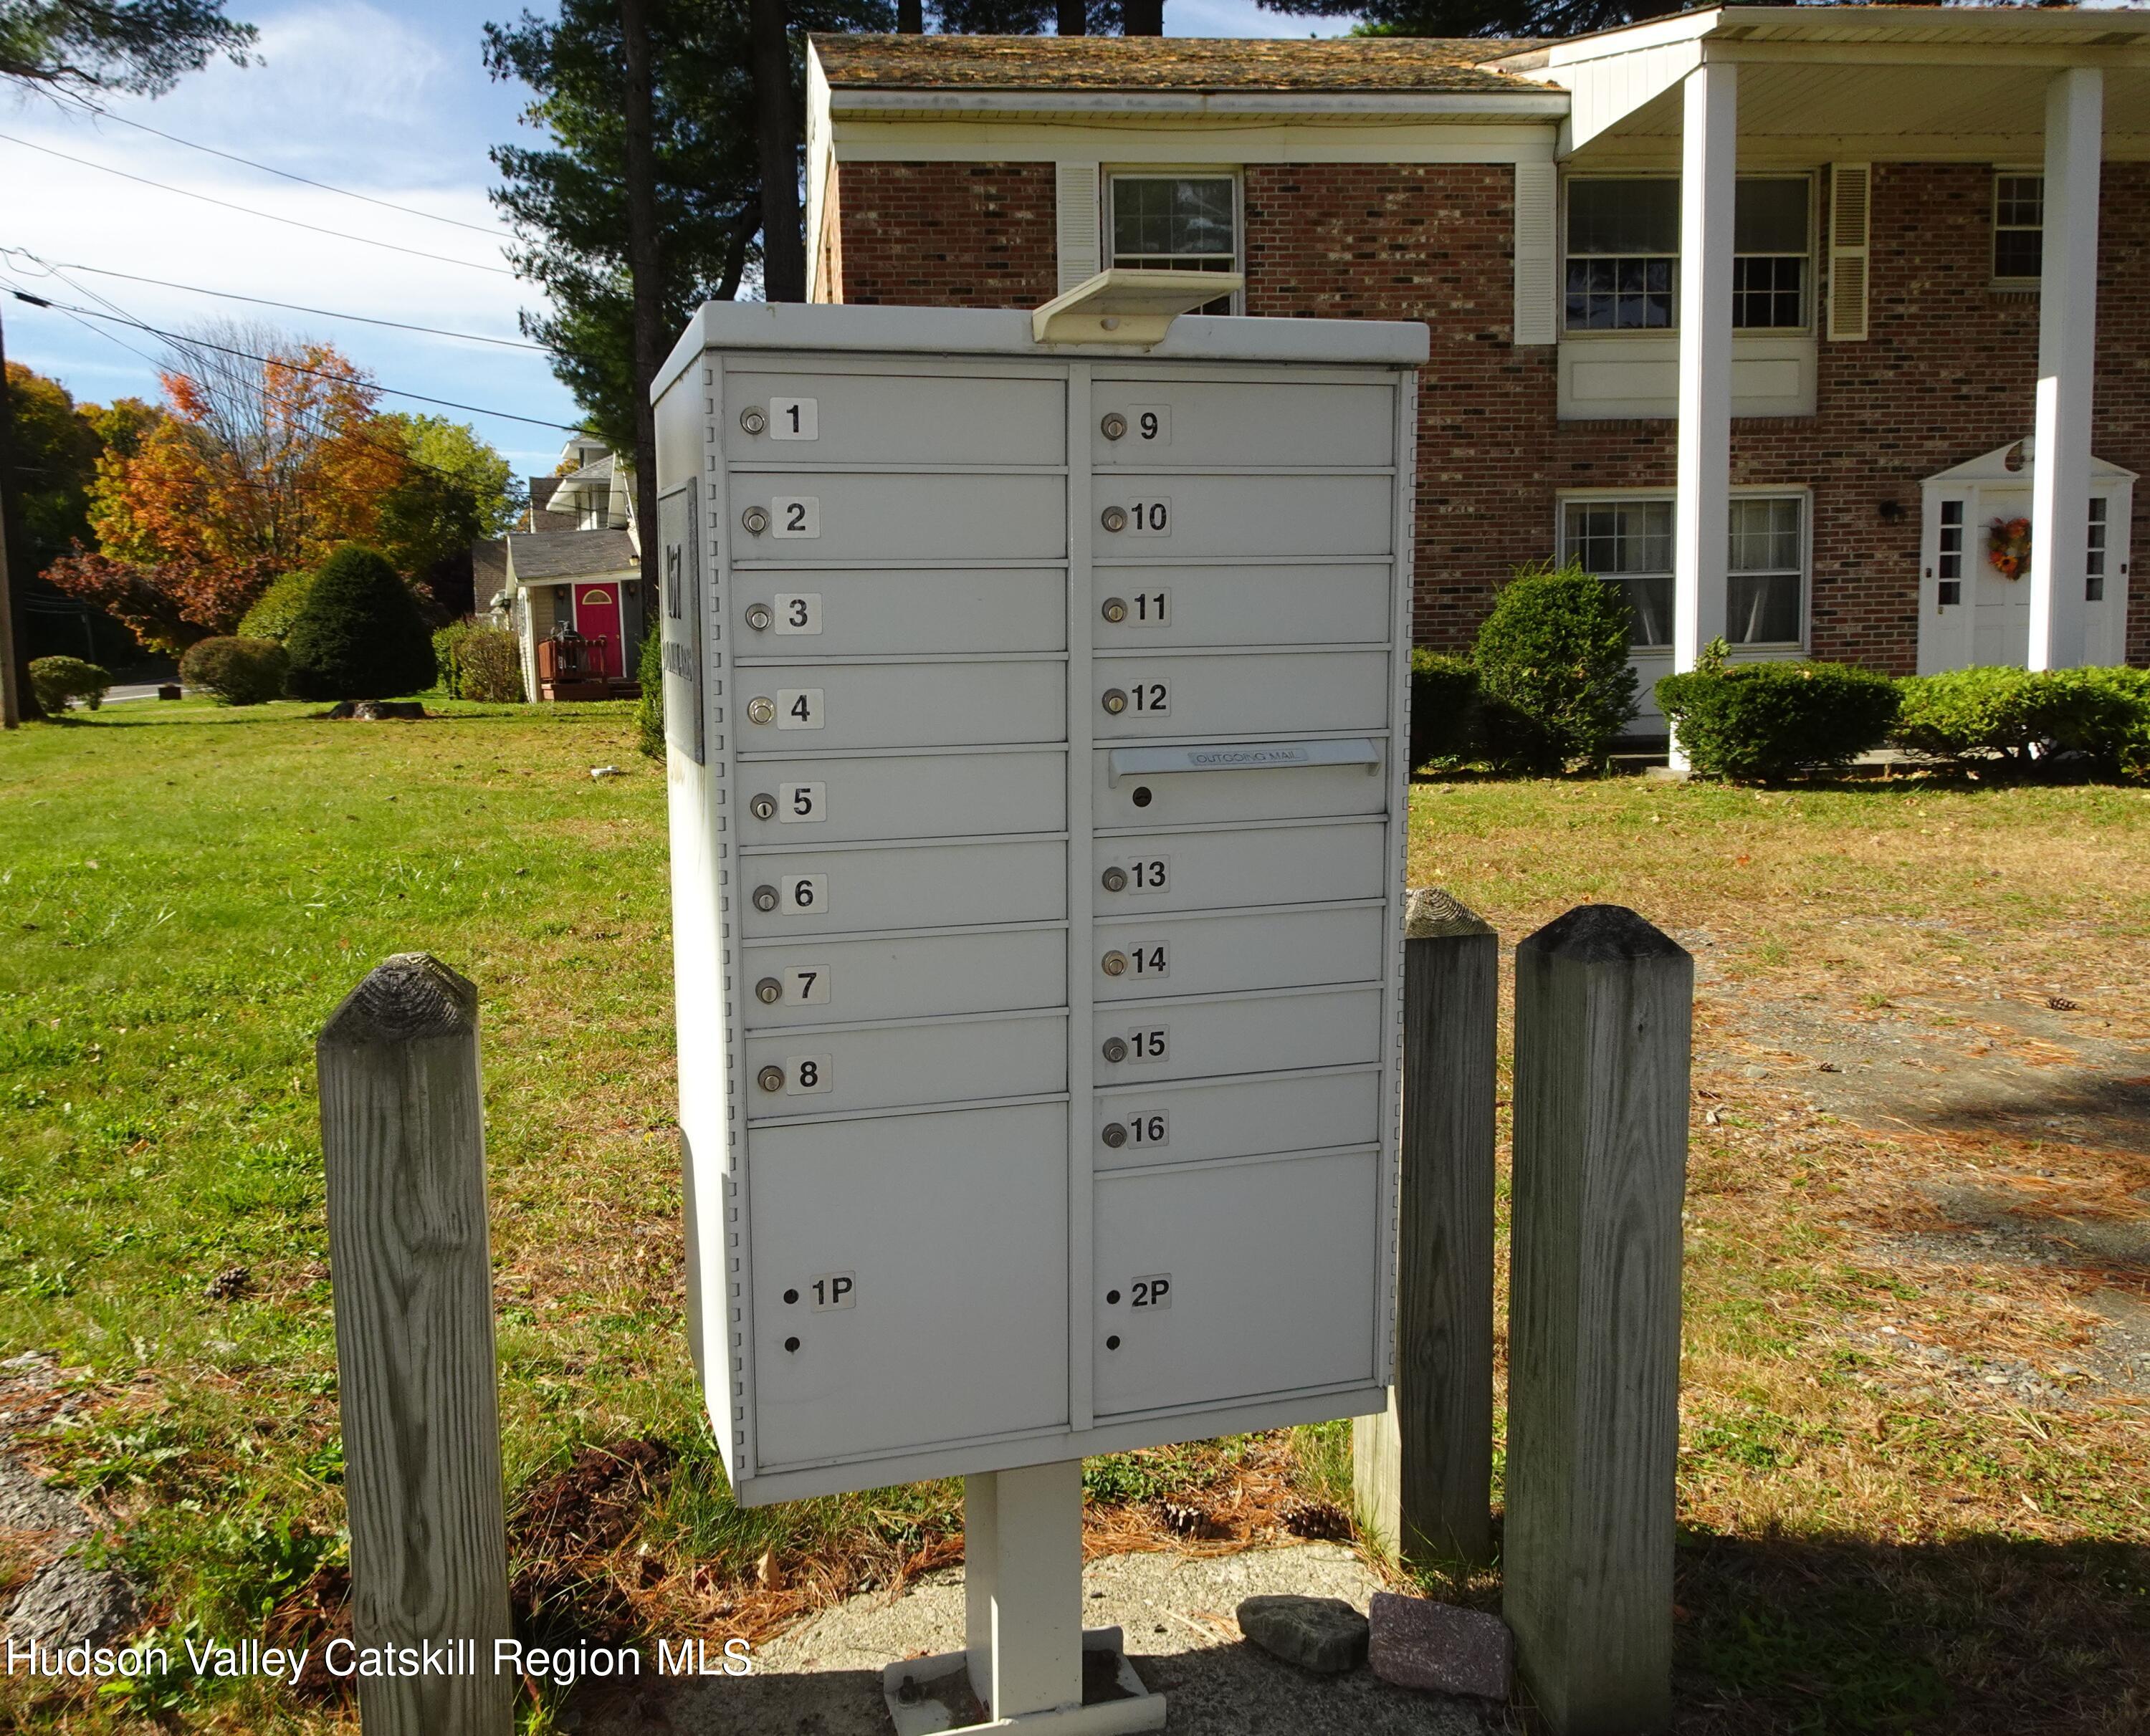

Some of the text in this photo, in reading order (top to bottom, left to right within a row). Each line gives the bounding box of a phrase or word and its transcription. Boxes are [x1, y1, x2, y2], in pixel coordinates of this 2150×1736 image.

[785, 403, 801, 433] 1
[1140, 412, 1158, 440] 9
[787, 503, 806, 531] 2
[1131, 503, 1167, 531] 10
[789, 599, 808, 627] 3
[1134, 593, 1165, 620] 11
[790, 694, 811, 722] 4
[1132, 684, 1167, 711] 12
[1196, 750, 1301, 763] OUTGOING MAIL
[794, 787, 812, 815] 5
[1132, 861, 1166, 888] 13
[795, 880, 813, 907] 6
[1132, 946, 1166, 973] 14
[798, 972, 817, 999] 7
[1131, 1031, 1165, 1058] 15
[799, 1061, 818, 1088] 8
[1131, 1116, 1165, 1142] 16
[812, 1277, 853, 1305] 1P
[1132, 1280, 1170, 1307] 2P
